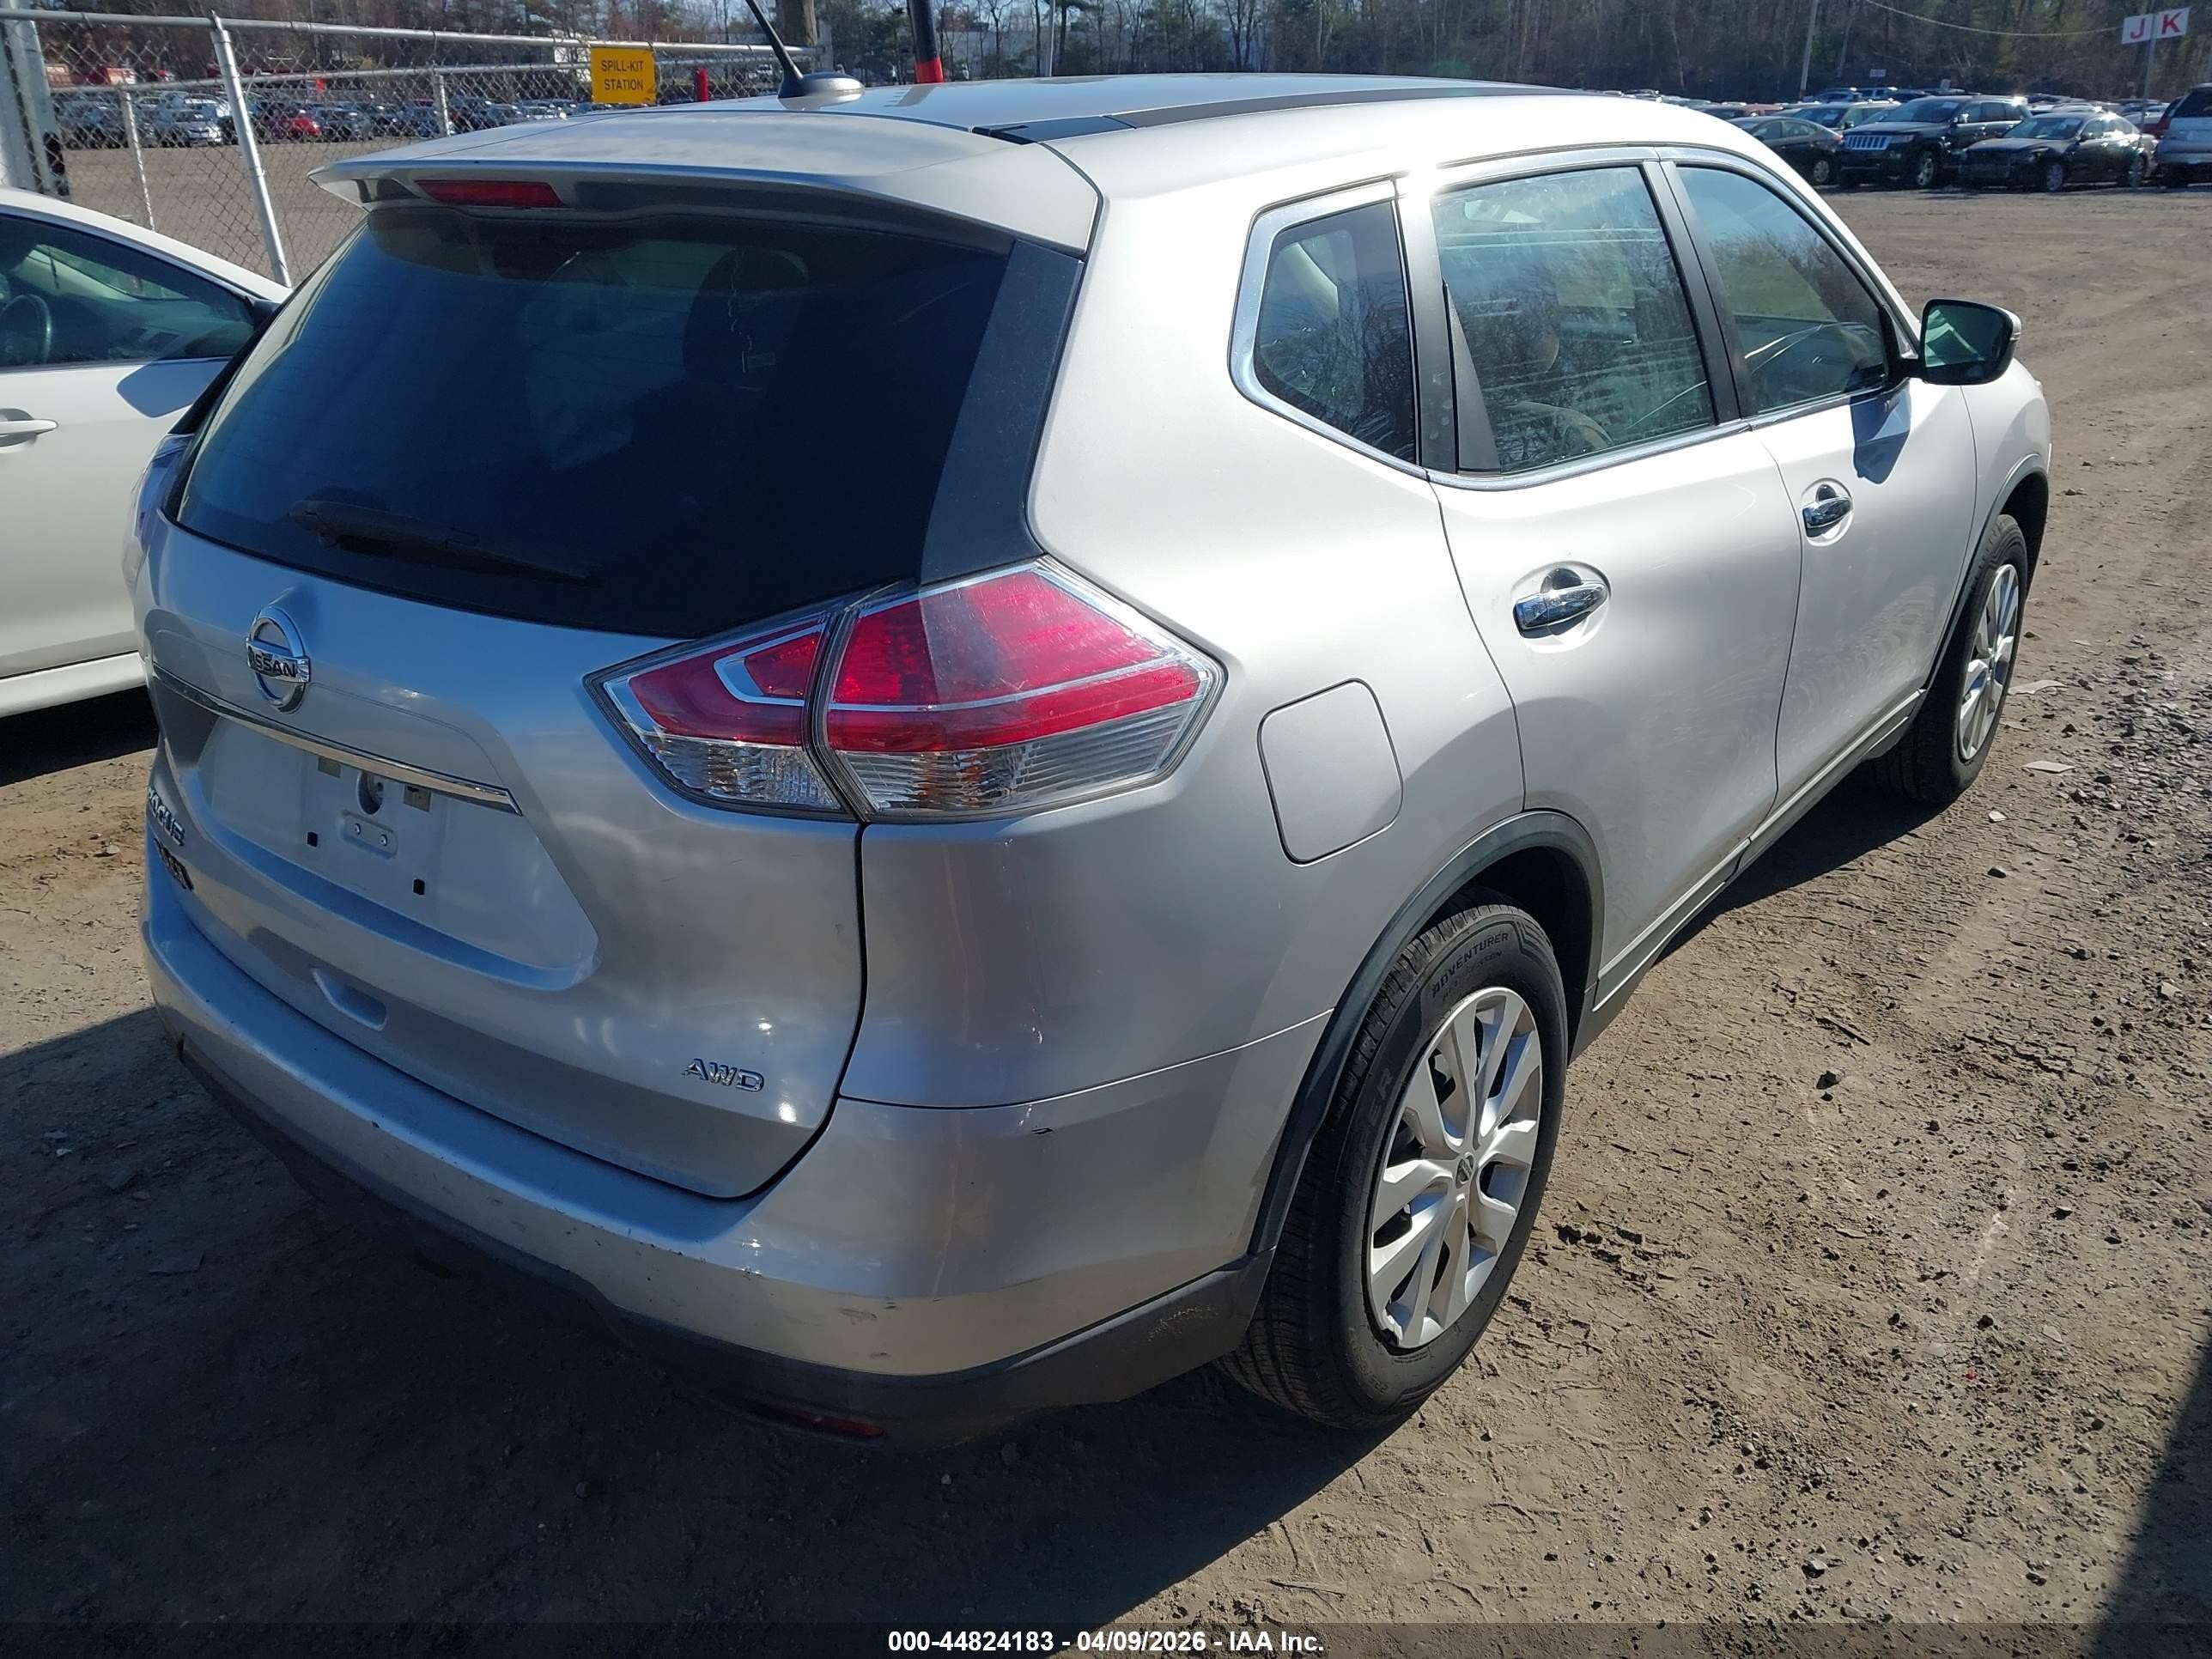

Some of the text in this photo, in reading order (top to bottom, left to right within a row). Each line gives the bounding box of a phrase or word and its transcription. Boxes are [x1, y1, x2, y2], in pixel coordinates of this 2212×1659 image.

[2130, 10, 2184, 40] J K
[600, 59, 644, 71] SPILL-KIT
[604, 77, 644, 91] STATION
[247, 646, 297, 678] NISSAN
[1431, 933, 1510, 999] ADVENTURER
[681, 1057, 765, 1093] AWD
